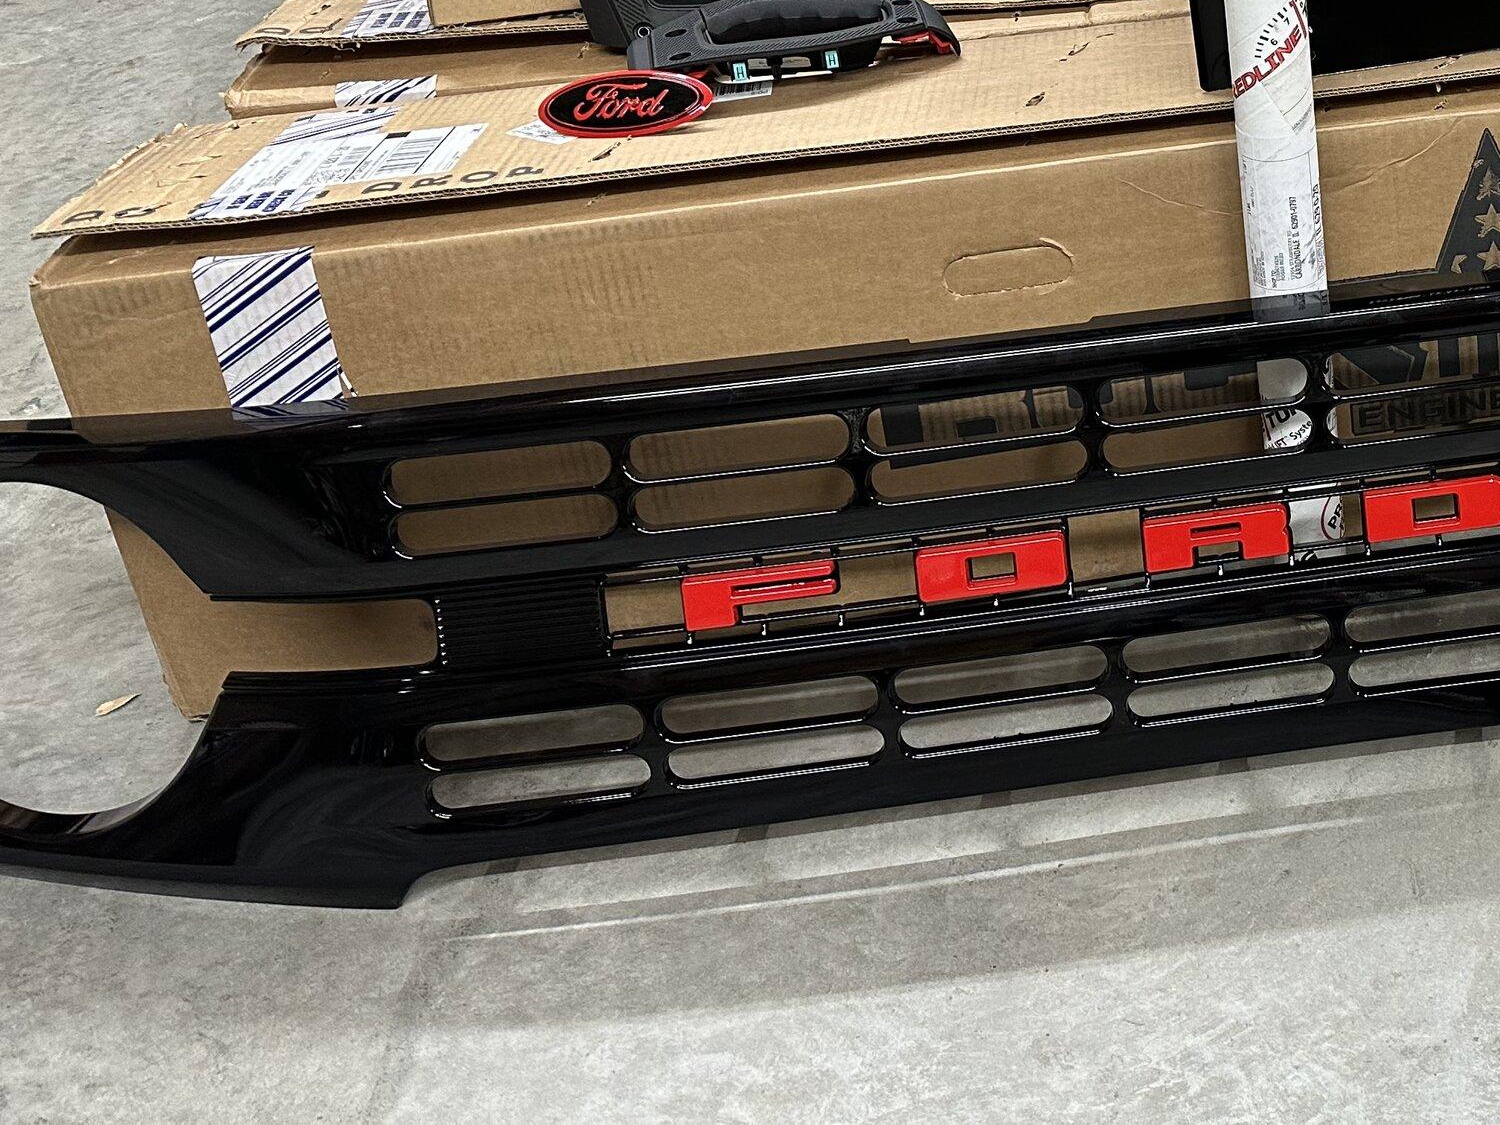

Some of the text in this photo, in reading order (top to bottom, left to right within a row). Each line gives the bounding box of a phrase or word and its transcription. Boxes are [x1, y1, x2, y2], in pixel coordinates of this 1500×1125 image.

[735, 63, 747, 79] H
[826, 51, 838, 68] H
[1233, 24, 1303, 99] EDLINE
[573, 82, 670, 121] Ford
[361, 165, 546, 195] DROP
[1289, 420, 1312, 441] Syste
